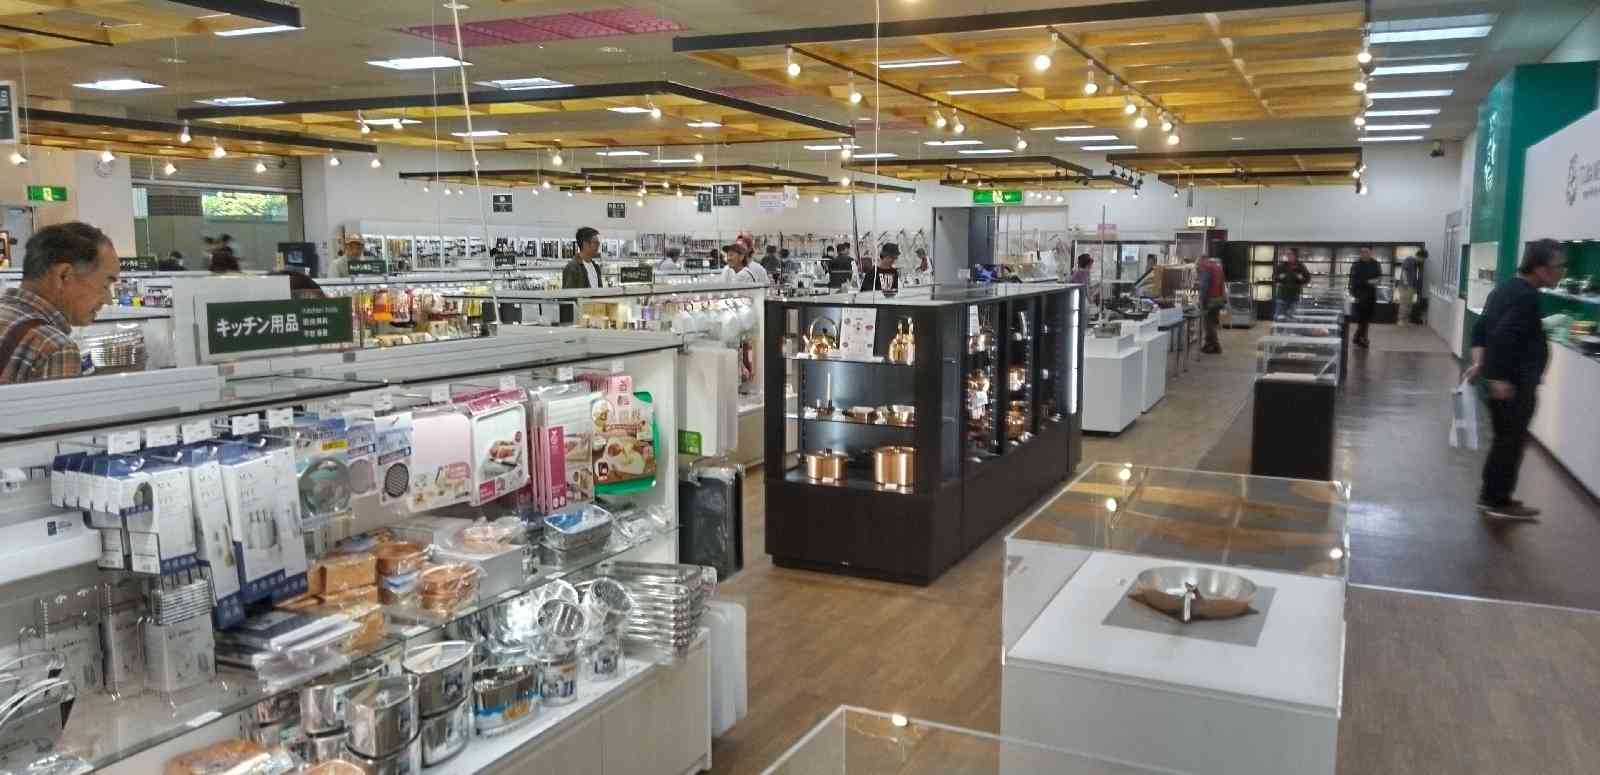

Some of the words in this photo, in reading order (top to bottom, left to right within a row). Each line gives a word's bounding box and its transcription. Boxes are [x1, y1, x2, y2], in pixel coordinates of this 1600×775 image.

[216, 313, 299, 337] キッチン用品
